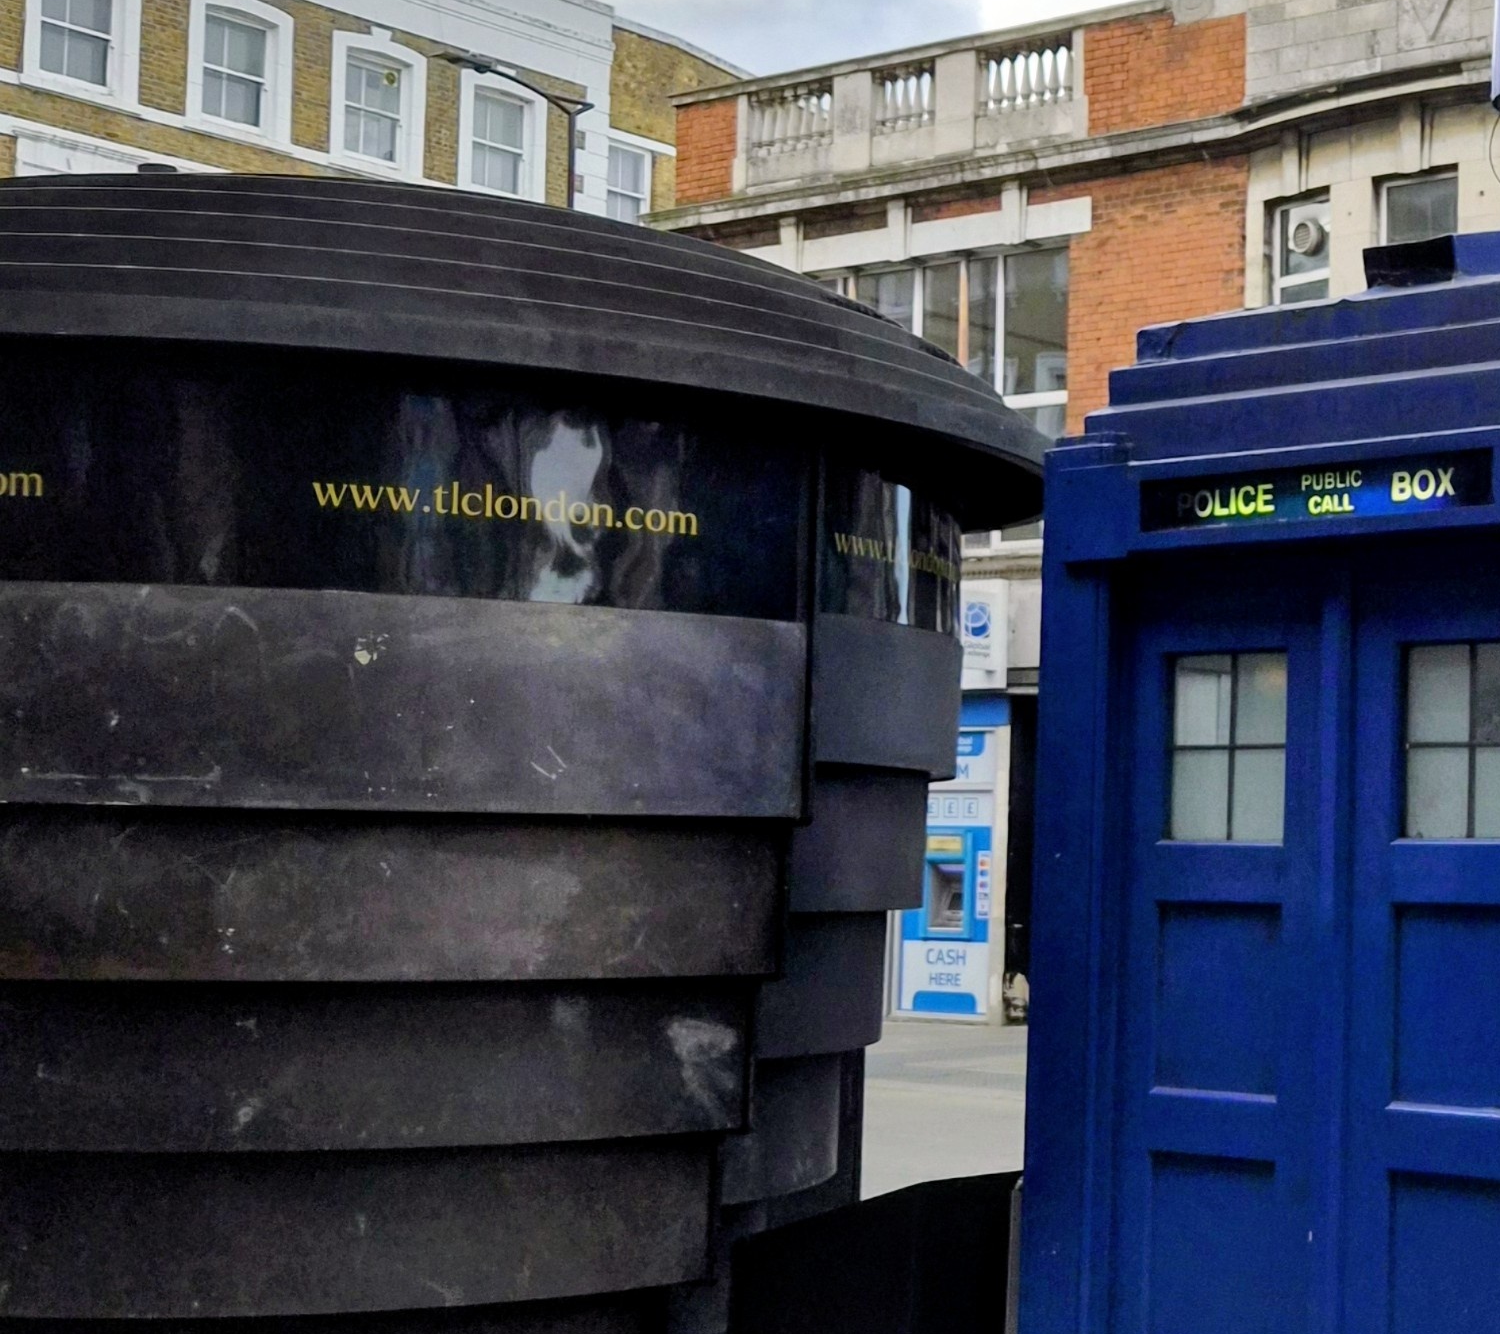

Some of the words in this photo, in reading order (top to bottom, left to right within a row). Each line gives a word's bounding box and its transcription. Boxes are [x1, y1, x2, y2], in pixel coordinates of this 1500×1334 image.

[1301, 469, 1363, 491] PUBLIC
[1390, 467, 1456, 502] BOX
[311, 480, 699, 536] www.tlclondon.com
[1177, 483, 1275, 518] POLICE
[1307, 493, 1355, 515] CALL
[925, 947, 967, 966] CASH
[928, 971, 962, 987] HERE
